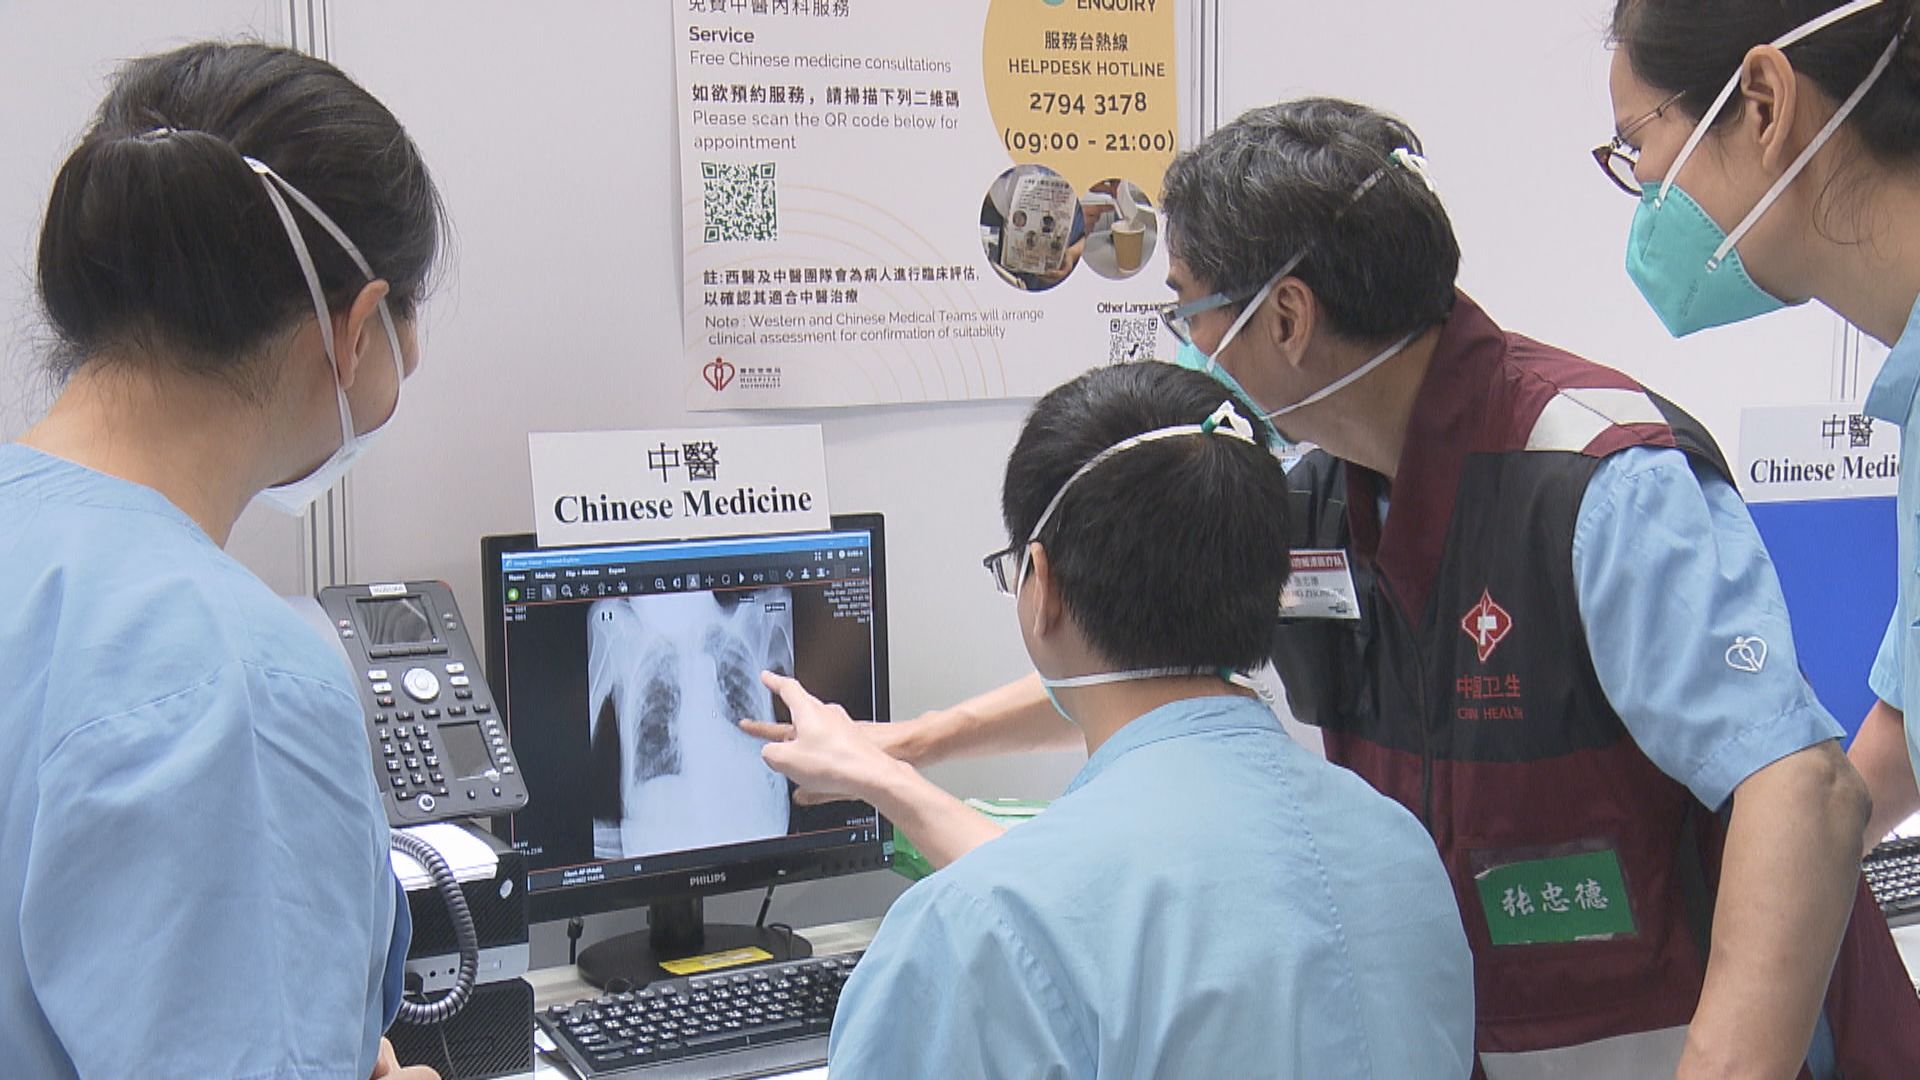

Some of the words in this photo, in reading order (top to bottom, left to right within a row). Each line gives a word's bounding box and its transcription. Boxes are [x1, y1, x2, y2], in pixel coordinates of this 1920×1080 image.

[1077, 0, 1157, 12] ENQUIRY
[689, 26, 755, 43] Service
[1044, 30, 1129, 52] 服務台熱線
[690, 50, 725, 65] Free
[729, 51, 790, 67] Chinese
[794, 53, 861, 69] medicine
[865, 56, 951, 73] consultations
[1008, 58, 1092, 75] HELPDESK
[1096, 61, 1166, 78] HOTLINE
[1029, 92, 1085, 115] 2794
[1094, 91, 1147, 115] 3178
[693, 109, 747, 126] Please
[752, 112, 789, 126] scan
[794, 111, 820, 127] the
[824, 112, 847, 128] QR
[852, 113, 890, 127] code
[894, 114, 936, 129] below
[940, 114, 958, 129] for
[694, 134, 797, 152] appointment
[1004, 128, 1079, 153] (09:00
[1105, 129, 1175, 152] 21:00)
[704, 288, 859, 306] 以確認其適合中醫治療
[1097, 302, 1123, 313] Other
[705, 315, 739, 329] Note
[749, 313, 806, 328] Western
[808, 312, 833, 326] and
[836, 311, 886, 326] Chinese
[889, 310, 936, 324] Medical
[939, 308, 977, 323] Teams
[980, 308, 999, 321] will
[1002, 308, 1045, 322] arrange
[708, 331, 756, 345] clinical
[760, 329, 836, 344] assessment
[840, 328, 858, 342] for
[860, 325, 935, 341] confirmation
[938, 325, 950, 339] of
[952, 324, 1006, 340] suitability
[1822, 413, 1873, 450] 中醫
[647, 442, 720, 483] 中醫
[1750, 457, 1836, 484] Chinese
[554, 494, 673, 524] Chinese
[683, 486, 812, 517] Medicine
[689, 872, 727, 886] PHILIPS
[1502, 878, 1608, 917] 张忠德
